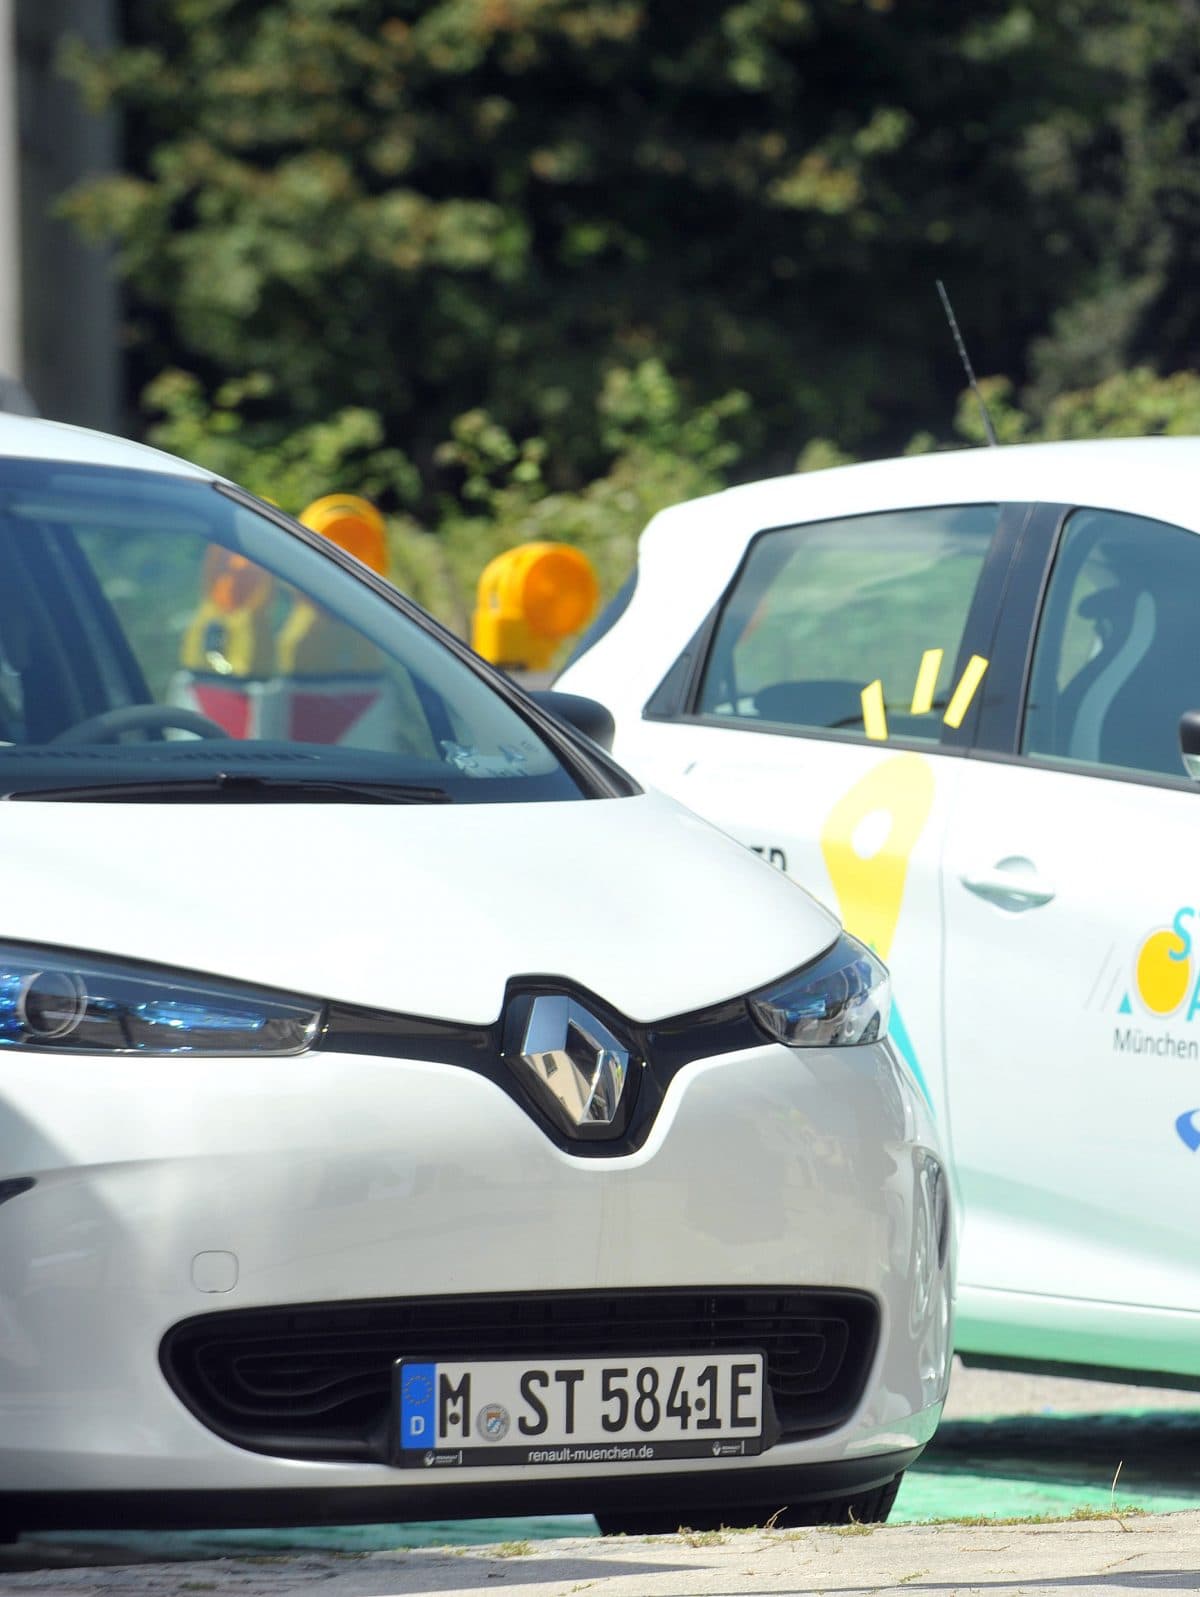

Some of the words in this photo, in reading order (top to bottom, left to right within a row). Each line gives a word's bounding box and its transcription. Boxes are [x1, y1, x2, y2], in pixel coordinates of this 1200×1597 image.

[439, 1372, 471, 1438] M
[518, 1369, 584, 1436] ST
[410, 1415, 425, 1436] D
[528, 1445, 654, 1463] renault-muenchen.de
